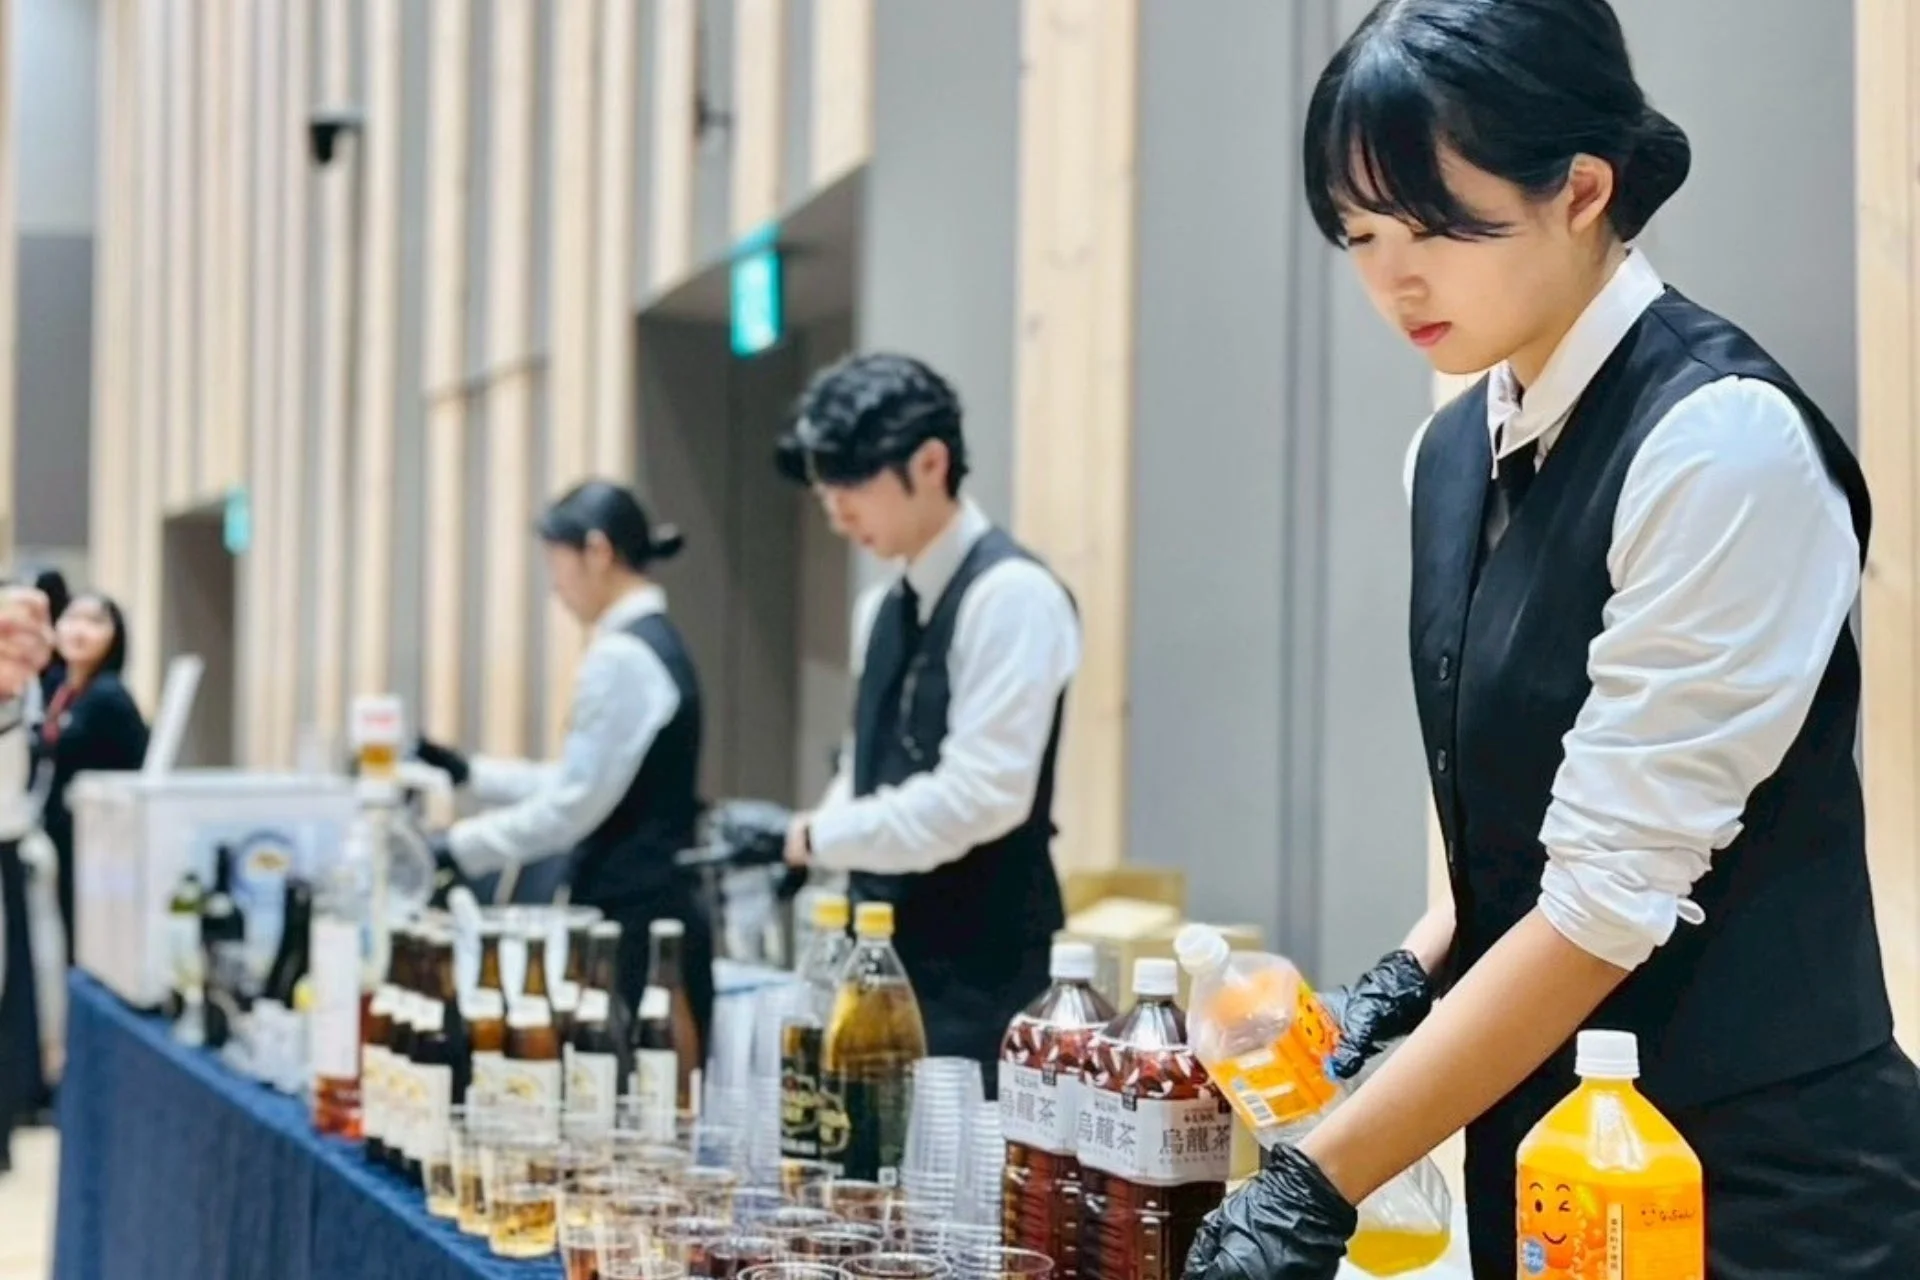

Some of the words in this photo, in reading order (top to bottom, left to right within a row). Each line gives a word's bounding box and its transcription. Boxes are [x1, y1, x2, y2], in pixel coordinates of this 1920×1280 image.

[1077, 1110, 1136, 1156] 烏龍茶
[1159, 1124, 1231, 1155] 烏龍茶
